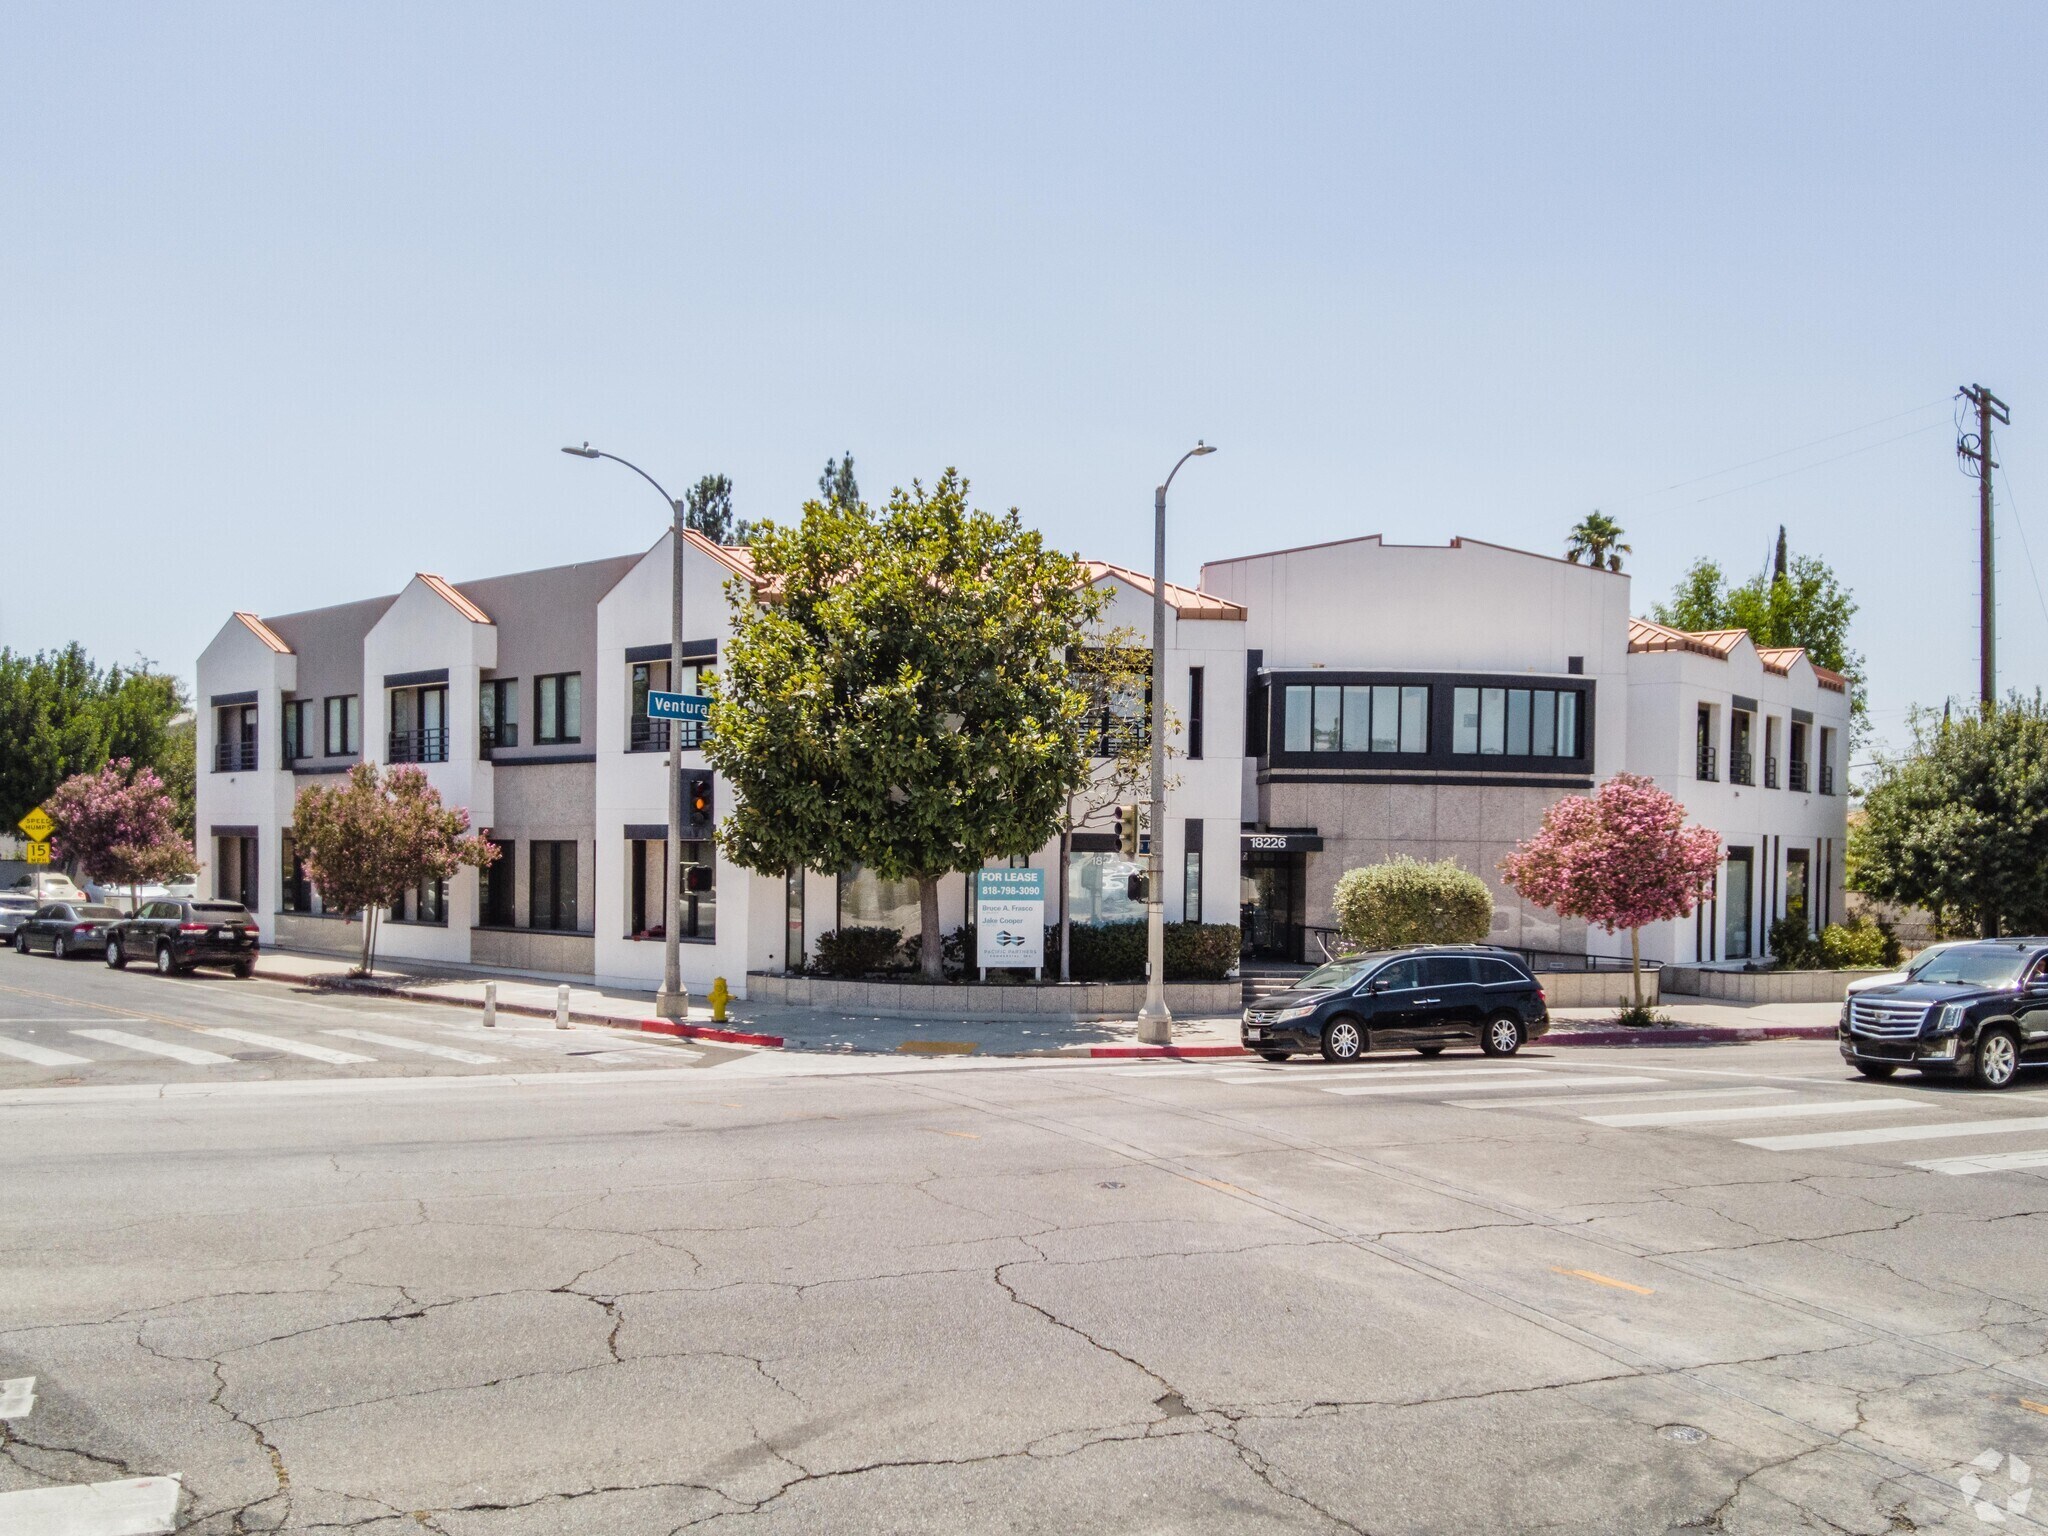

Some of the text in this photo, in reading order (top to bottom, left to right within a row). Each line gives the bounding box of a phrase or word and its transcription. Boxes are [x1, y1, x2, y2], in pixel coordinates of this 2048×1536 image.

[655, 697, 708, 715] Ventura
[1250, 837, 1287, 849] 18226
[31, 844, 46, 856] 15
[981, 872, 1038, 882] FOR LEASE
[982, 886, 1040, 895] 818-798-3090
[982, 904, 1001, 912] Bruce
[1011, 904, 1033, 912] Frasco
[999, 917, 1023, 925] Cooper
